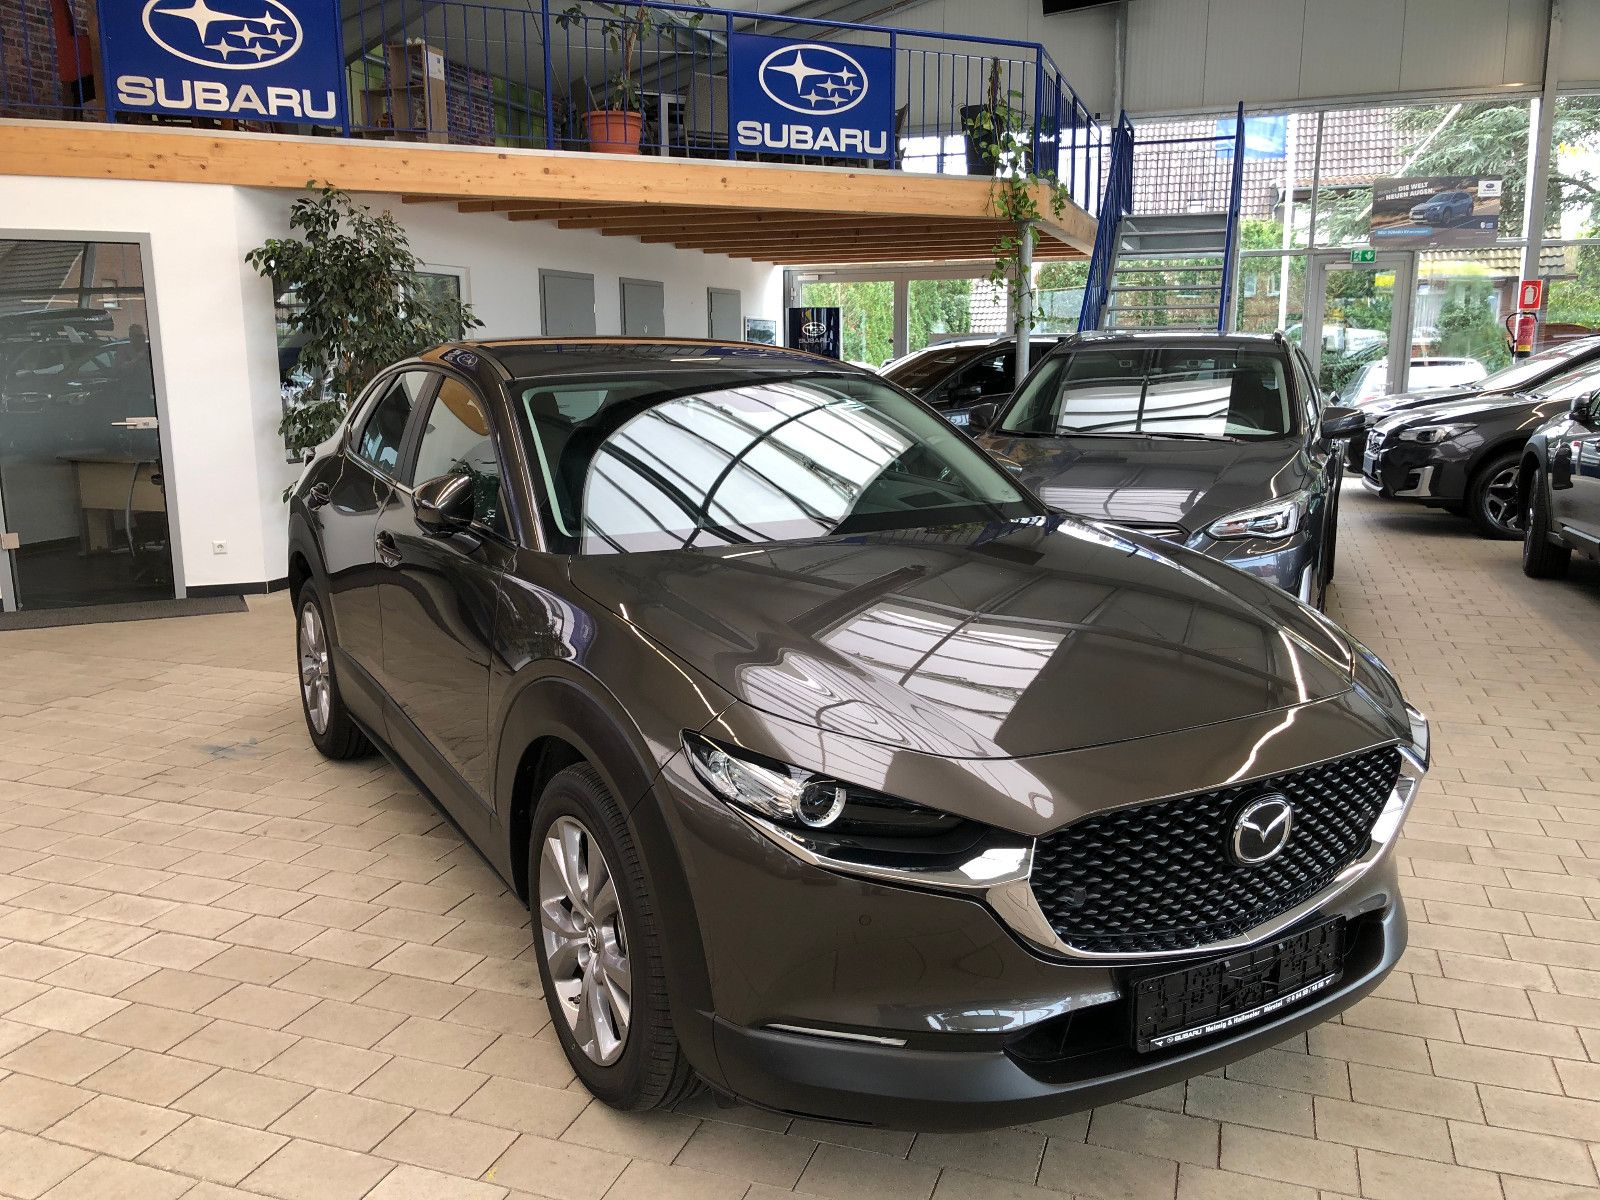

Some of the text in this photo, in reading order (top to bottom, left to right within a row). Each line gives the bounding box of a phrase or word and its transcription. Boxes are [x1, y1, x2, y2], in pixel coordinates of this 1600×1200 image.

[116, 75, 337, 119] SUBARU
[736, 120, 886, 155] SUBARU
[1398, 184, 1410, 192] DIE
[1410, 181, 1429, 190] WELT
[1385, 190, 1409, 201] NEUEN
[1174, 1028, 1203, 1042] SUBARU
